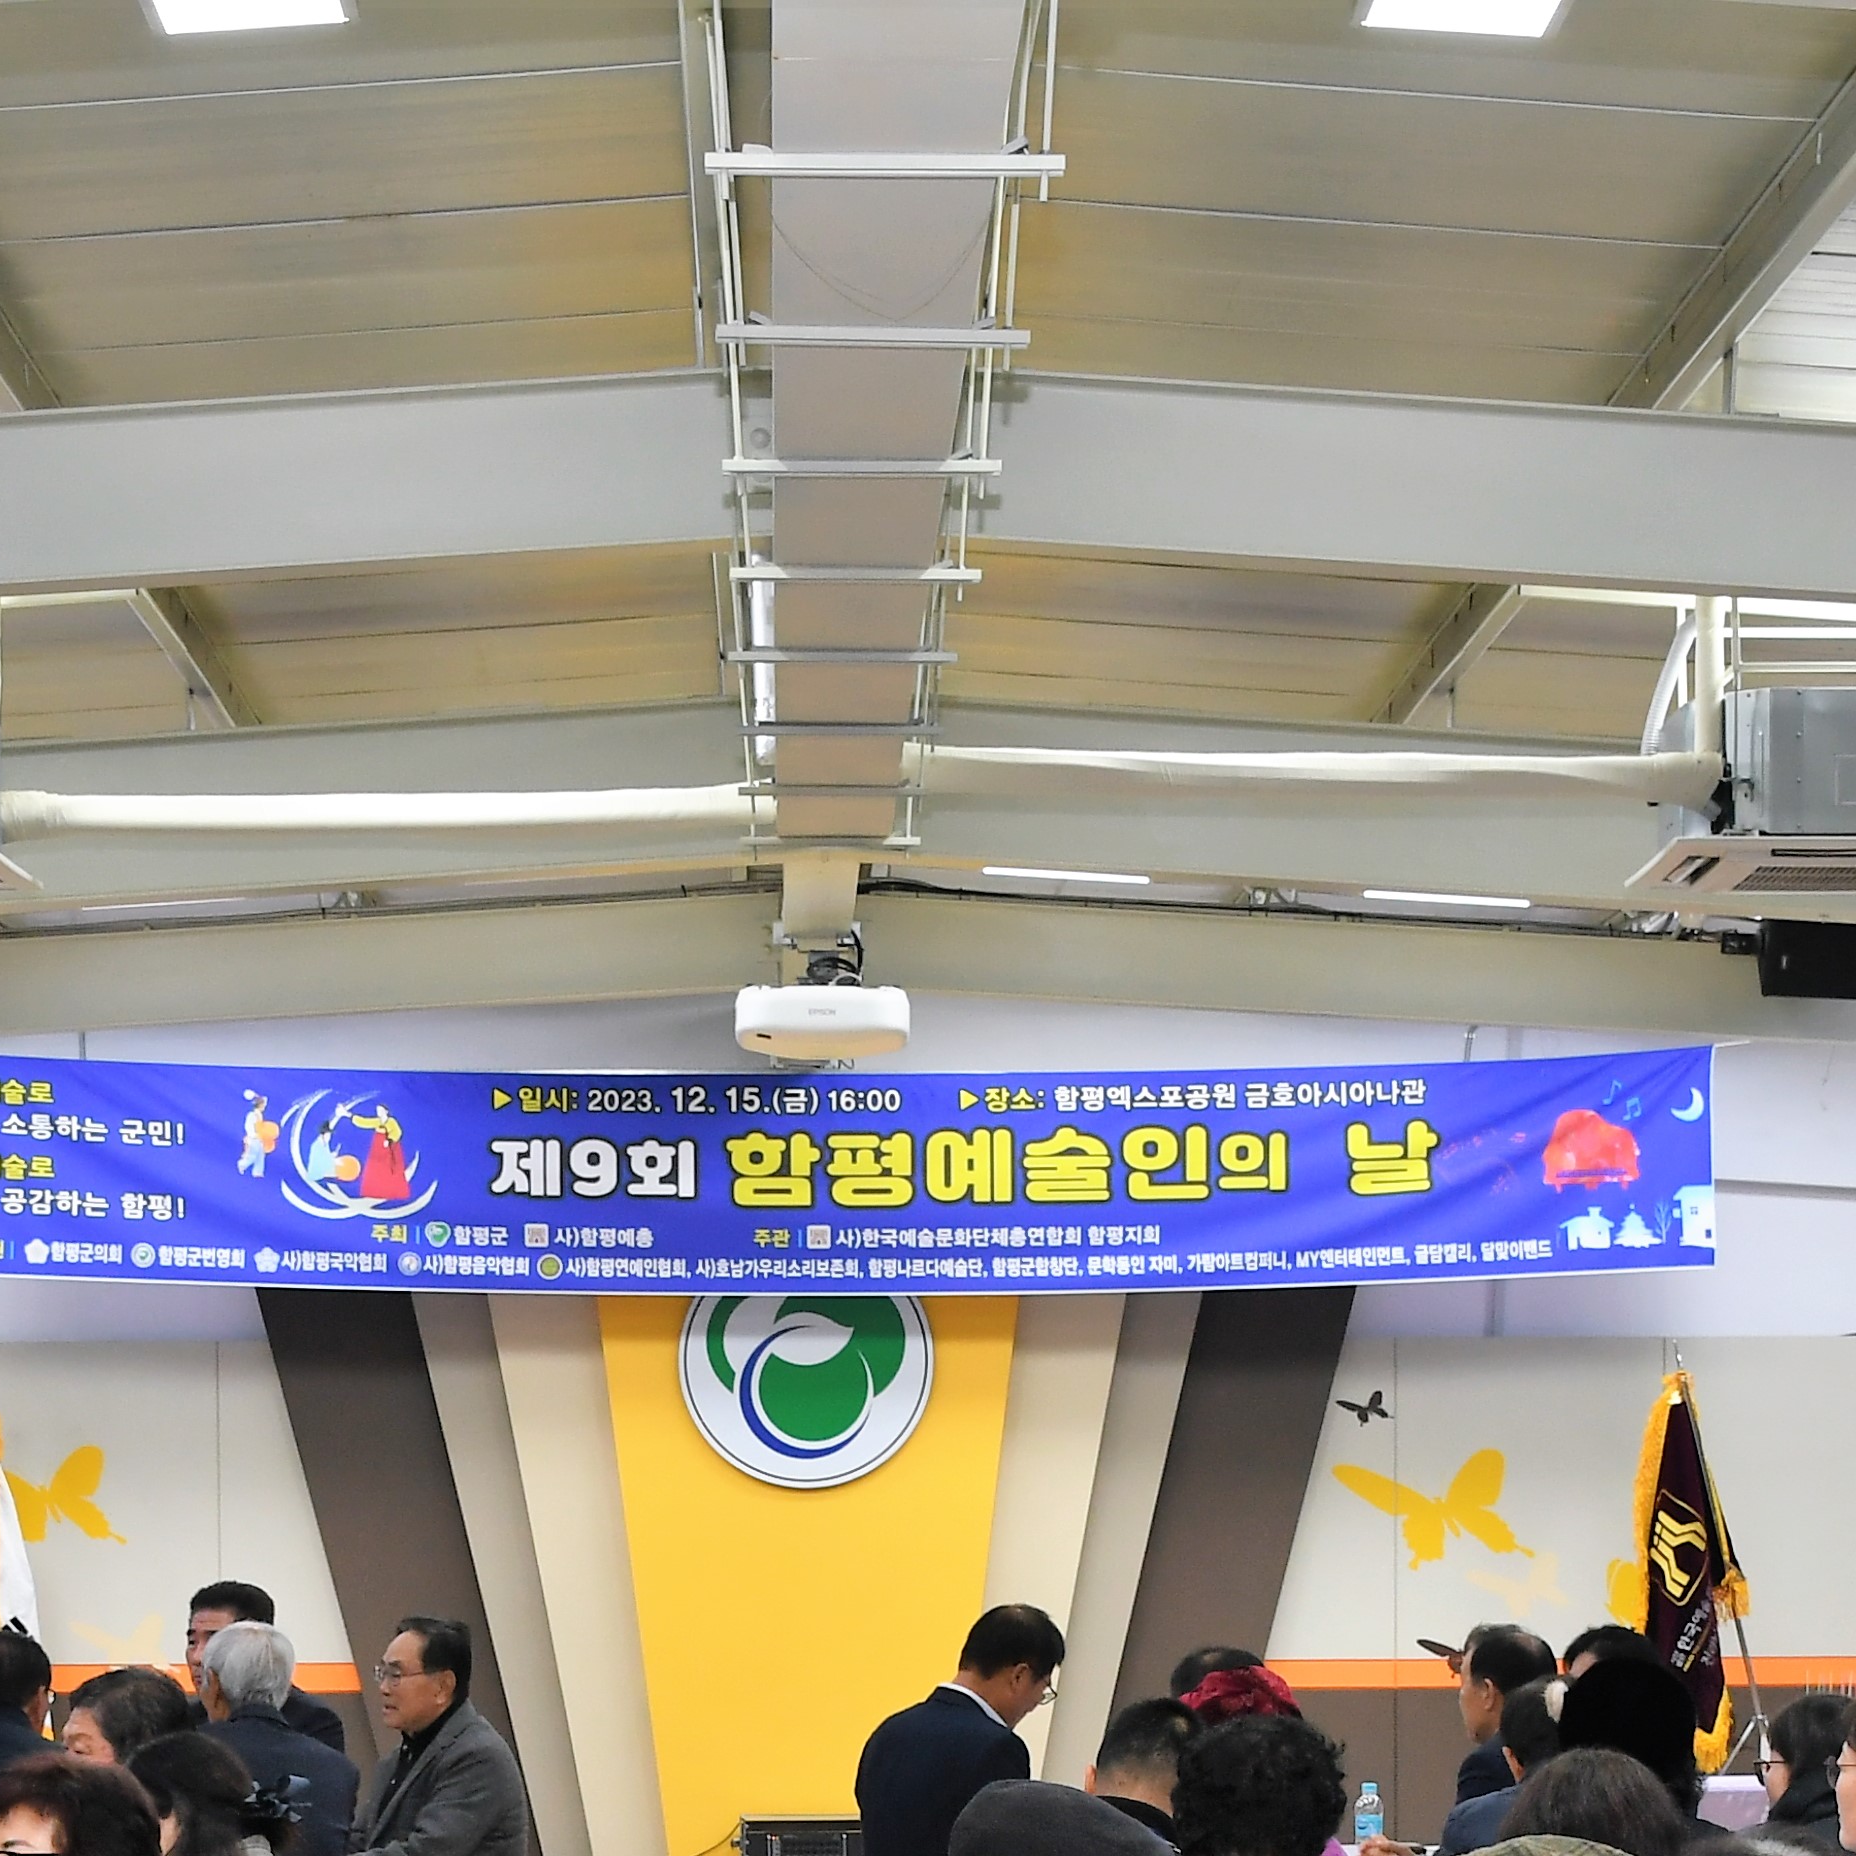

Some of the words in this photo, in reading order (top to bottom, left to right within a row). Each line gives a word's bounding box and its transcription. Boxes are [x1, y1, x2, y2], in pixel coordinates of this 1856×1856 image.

[517, 1087, 579, 1113] 일시:
[586, 1088, 662, 1113] 2023.
[671, 1087, 717, 1114] 12.
[725, 1087, 818, 1115] 15.(금)
[827, 1088, 902, 1113] 16:00
[985, 1086, 1045, 1112] 장소:
[1054, 1082, 1236, 1112] 함평엑스포공원
[1244, 1078, 1427, 1108] 금호아시아나관
[1, 1112, 109, 1143] 소통하는
[119, 1118, 185, 1147] 군민!
[489, 1136, 697, 1199] 제9회
[724, 1124, 1289, 1209] 함평예술인의
[1345, 1118, 1440, 1197] 날
[1, 1187, 110, 1218] 공감하는
[120, 1192, 186, 1221] 함평!
[370, 1223, 409, 1245] 주최
[453, 1224, 510, 1247] 함평군
[554, 1226, 655, 1249] 사)함평예총
[752, 1226, 791, 1249] 주관
[835, 1224, 1083, 1249] 사)한국예술문화단체총연합회
[1087, 1224, 1161, 1247] 함평지회
[49, 1240, 124, 1266] 함평군의회
[157, 1244, 246, 1270] 함평군번영회
